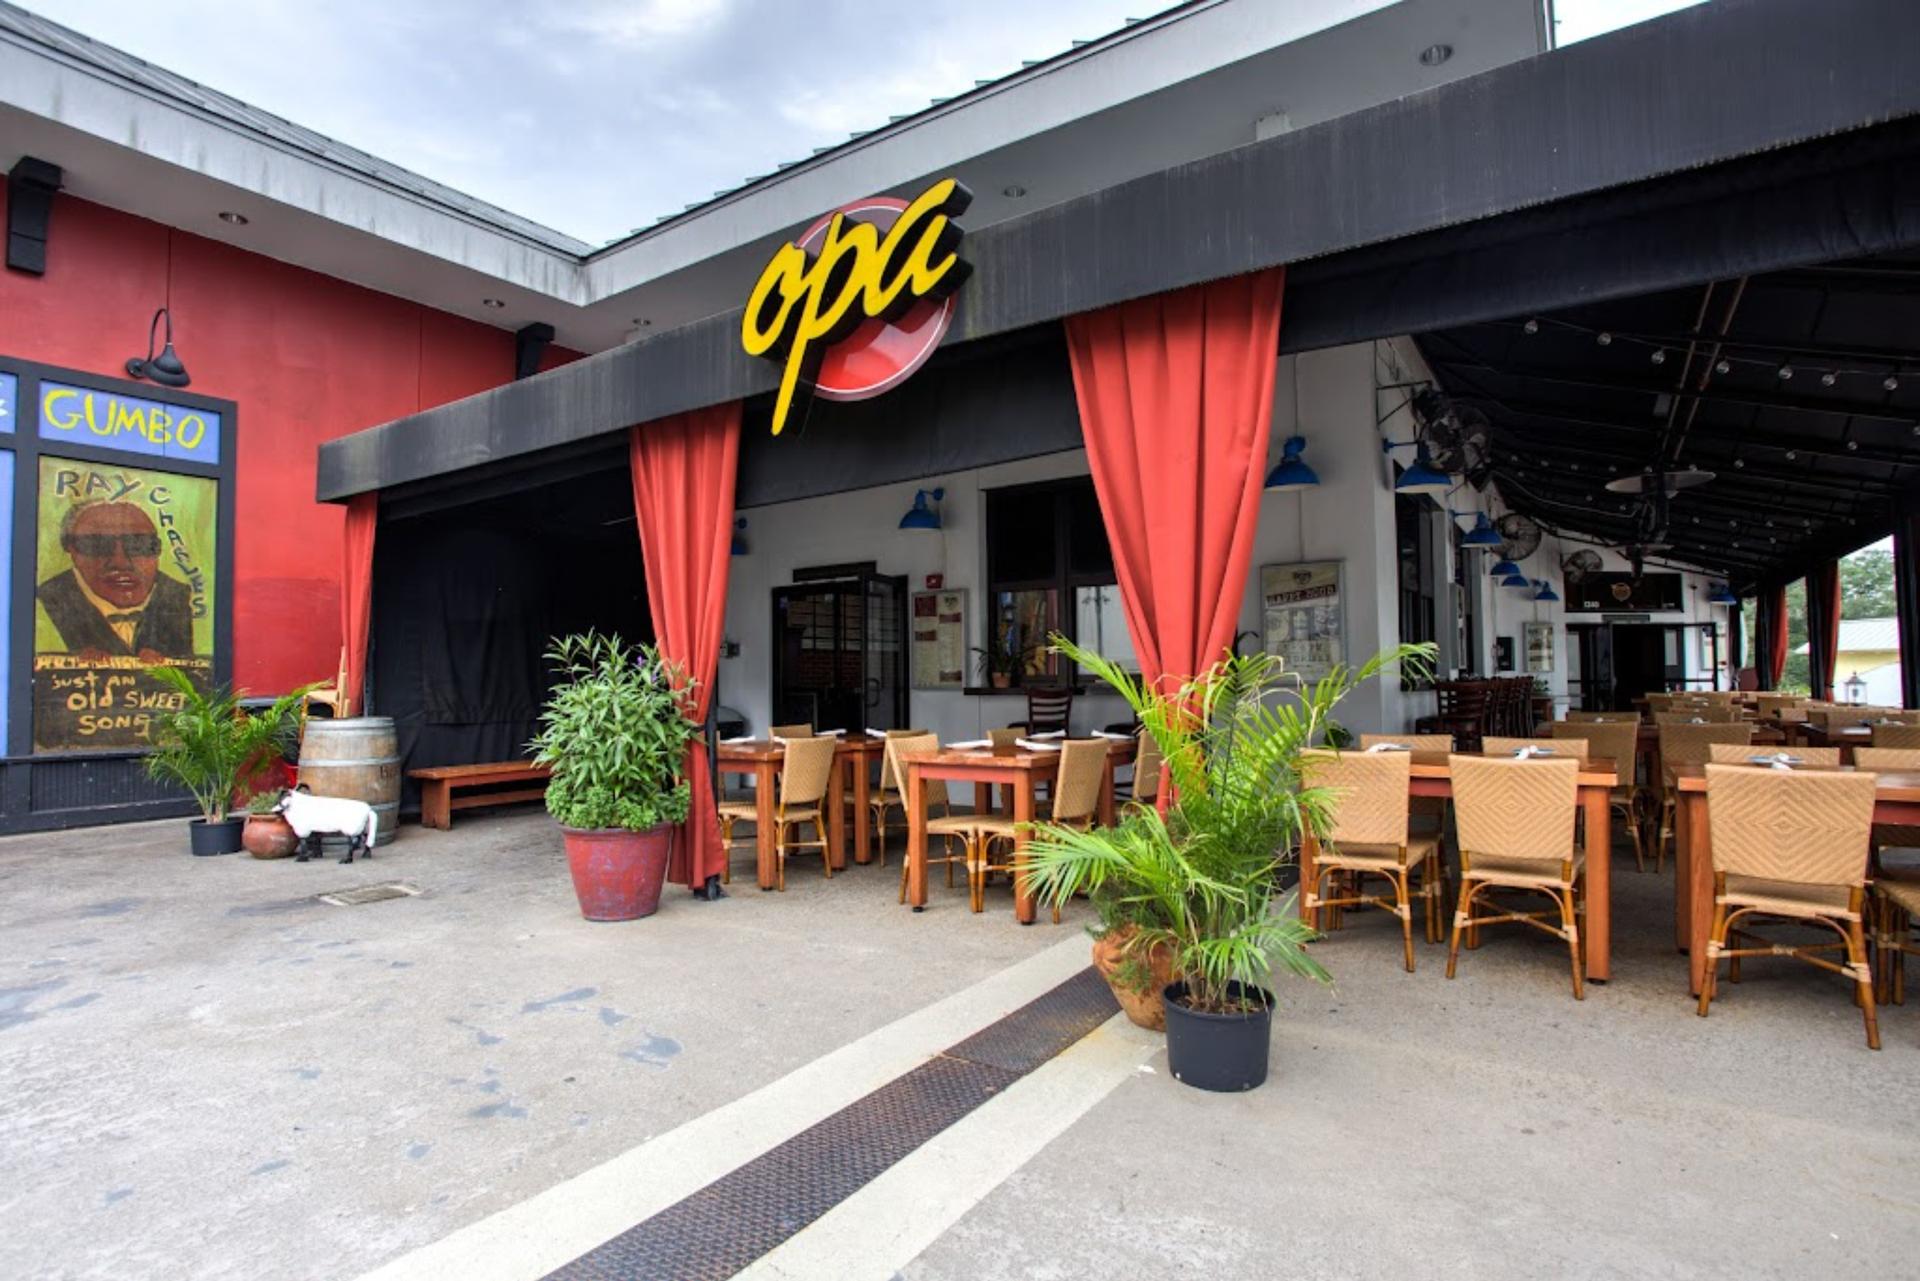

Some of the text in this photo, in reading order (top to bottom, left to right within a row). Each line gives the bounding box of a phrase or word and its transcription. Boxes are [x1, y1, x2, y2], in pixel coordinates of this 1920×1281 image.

[742, 178, 958, 436] opa
[44, 389, 205, 449] GUMBO
[55, 468, 144, 504] RAY
[107, 675, 136, 687] AN
[124, 690, 188, 710] SWEET
[78, 714, 152, 740] SONG
